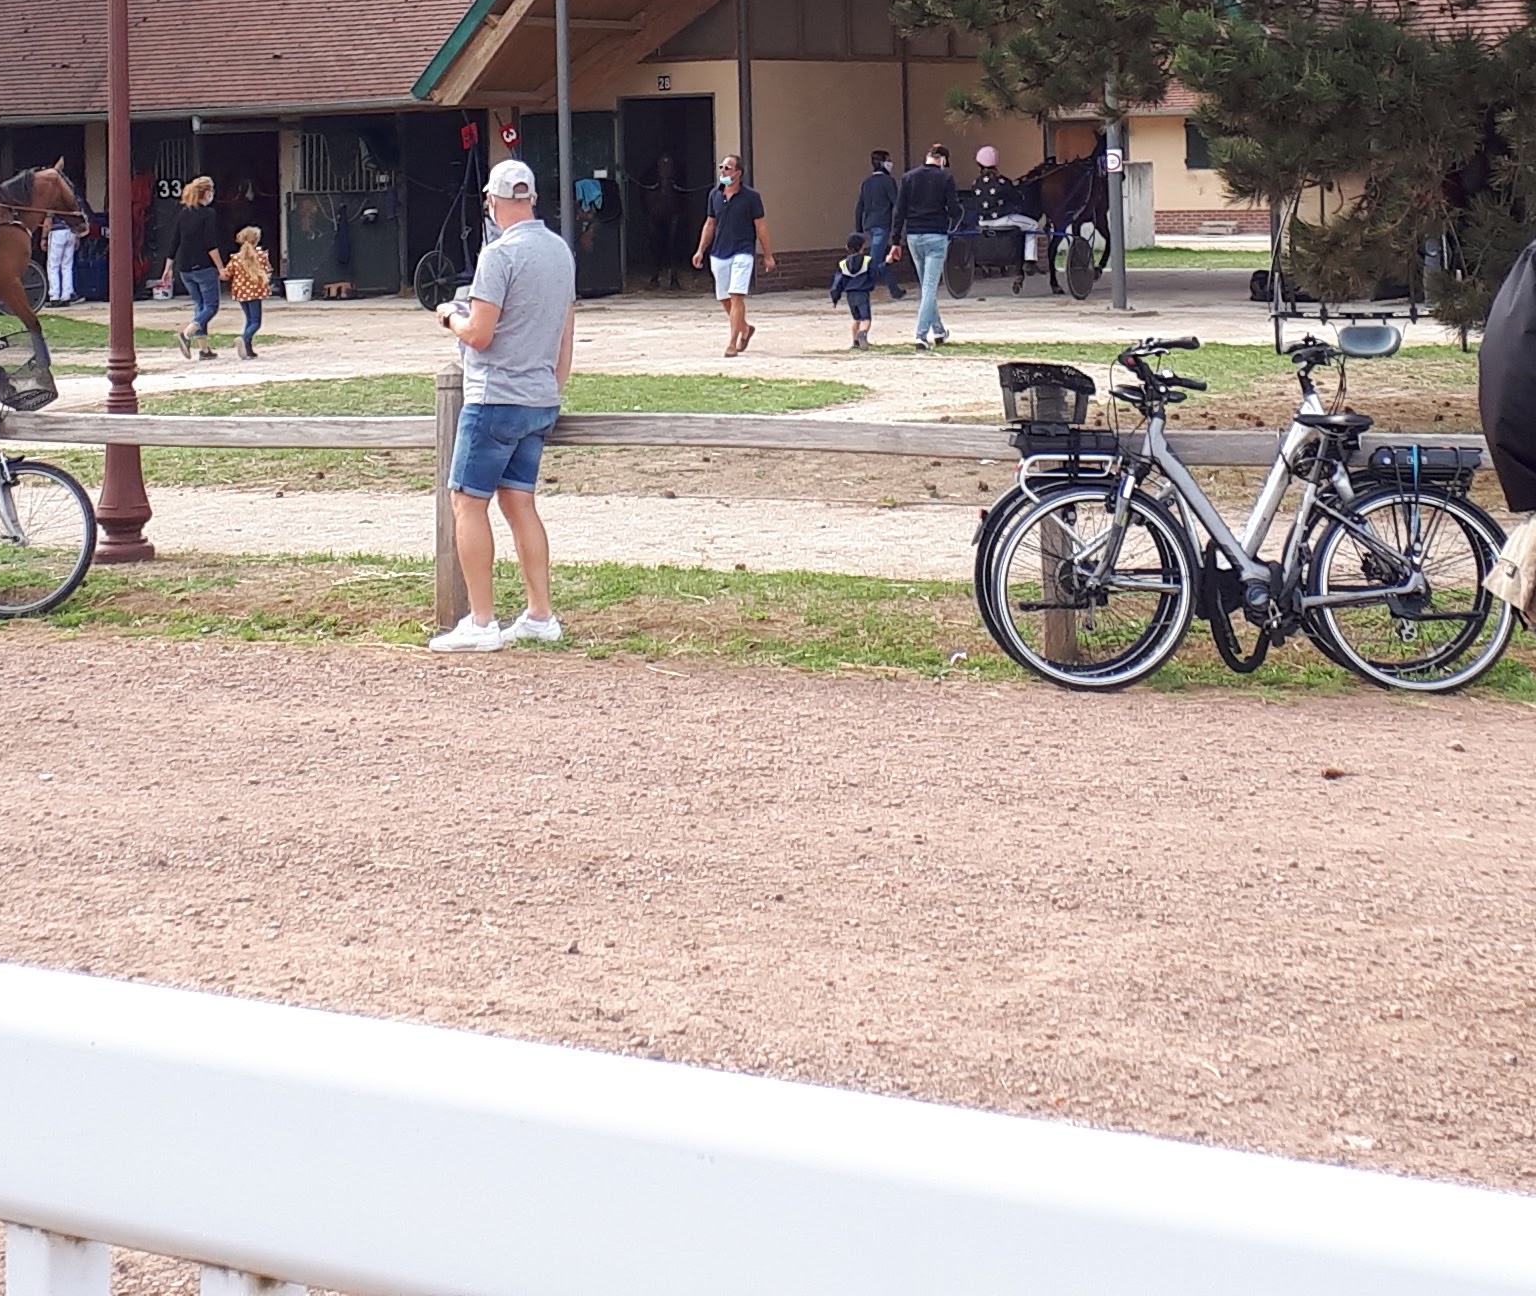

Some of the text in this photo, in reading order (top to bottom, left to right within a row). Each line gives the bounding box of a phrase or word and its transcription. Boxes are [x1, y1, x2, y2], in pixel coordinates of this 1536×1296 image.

[658, 77, 671, 90] 28
[502, 128, 517, 143] 3
[158, 179, 182, 198] 33
